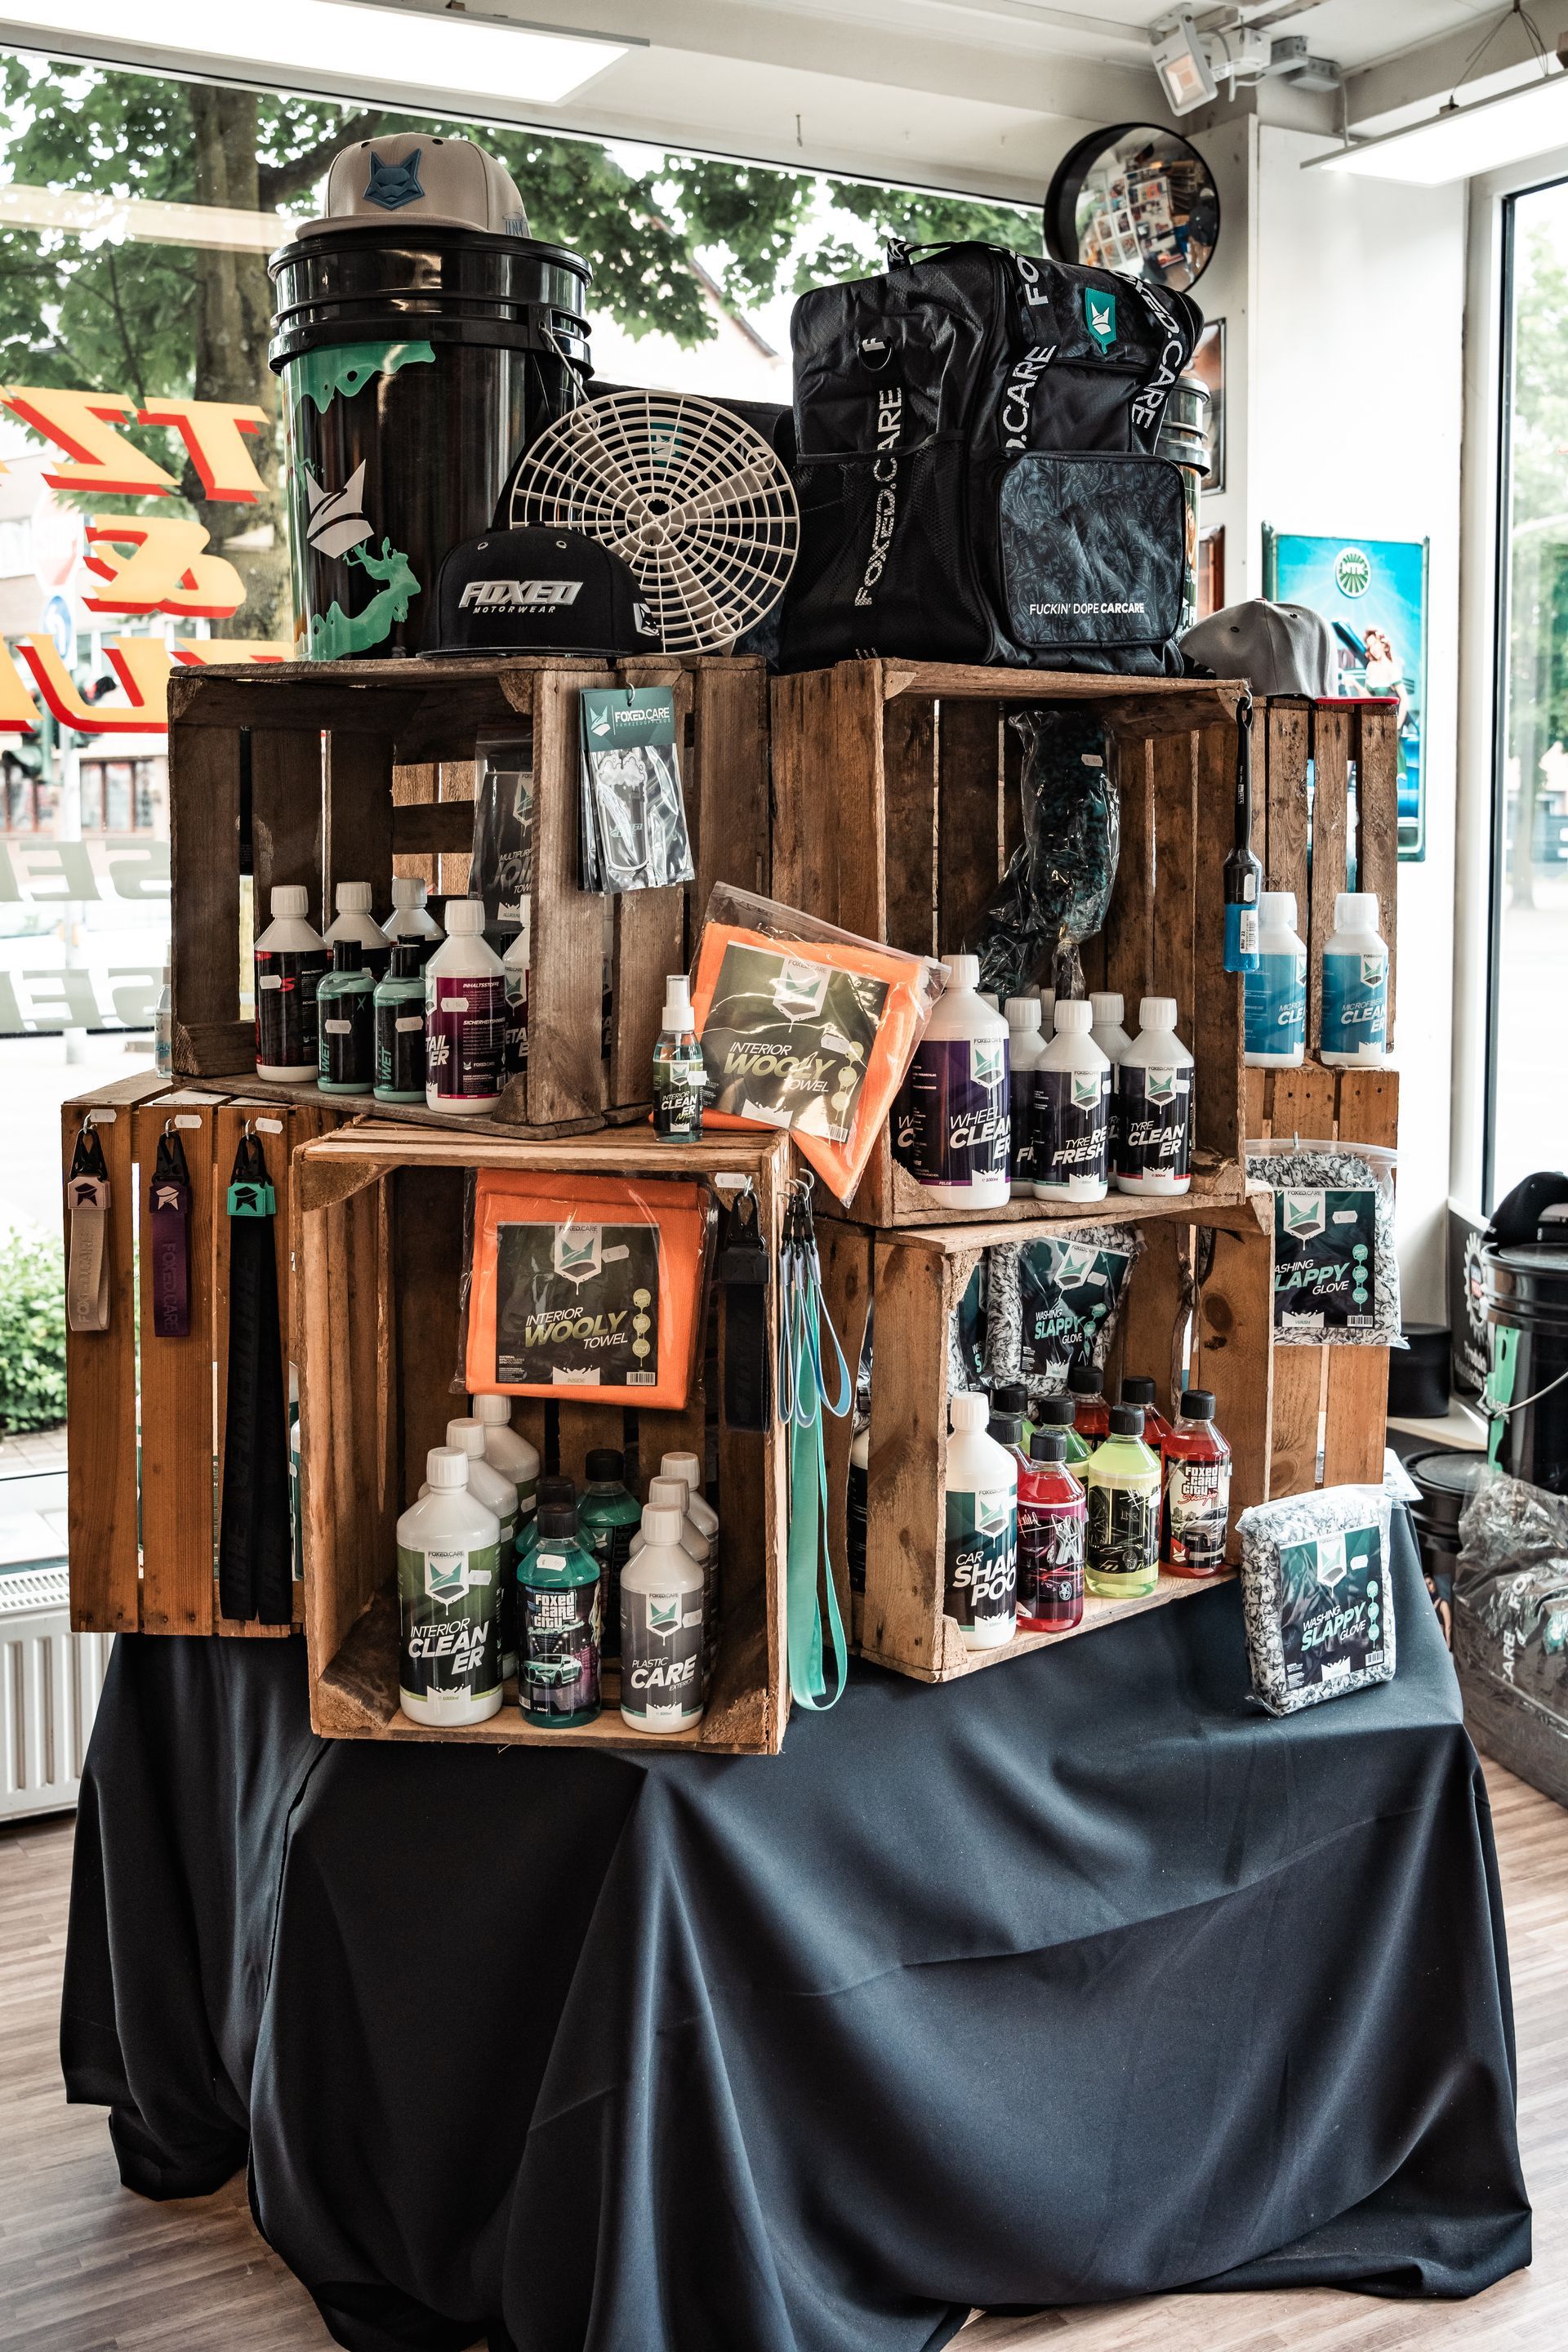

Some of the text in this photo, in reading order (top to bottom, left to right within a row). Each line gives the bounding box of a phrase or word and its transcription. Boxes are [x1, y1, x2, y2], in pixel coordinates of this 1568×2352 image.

[854, 387, 902, 606] FOXED.CARE
[459, 581, 583, 608] FOXED
[473, 605, 556, 614] MOTORWEAR
[1030, 602, 1144, 615] FUCKIN' DOPE CARCARE
[615, 707, 670, 723] FOXED.CARE
[1342, 998, 1384, 1012] MICROFIBER
[322, 1039, 330, 1071] WET
[430, 1049, 449, 1067] ER
[730, 1042, 792, 1055] INTERIOR
[382, 1046, 392, 1080] WET
[784, 1079, 829, 1093] TOWEL
[662, 1091, 689, 1101] INTERIOR
[662, 1094, 697, 1110] CLEAN
[681, 1105, 696, 1116] ER
[951, 1106, 1001, 1129] WHEEL
[1129, 1123, 1185, 1146] CLEAN
[1131, 1120, 1155, 1131] TYRE
[1066, 1136, 1091, 1149] TYRE
[1090, 1125, 1107, 1143] RE
[1052, 1142, 1106, 1166] FRESH
[1160, 1138, 1182, 1156] ER
[1312, 1281, 1349, 1295] GLOVE
[526, 1307, 583, 1326] INTERIOR
[1036, 1308, 1062, 1321] WASHING
[525, 1311, 628, 1348] WOOLY
[1035, 1316, 1087, 1340] SLAPPY
[583, 1333, 628, 1349] TOWEL
[1062, 1333, 1083, 1344] GLOVE
[956, 1551, 984, 1566] CAR
[971, 1566, 1016, 1606] POO
[411, 1618, 470, 1637] INTERIOR
[1301, 1601, 1365, 1651] SLAPPY
[1303, 1606, 1341, 1632] WASHING
[408, 1621, 489, 1658] CLEAN
[1340, 1619, 1366, 1641] GLOVE
[451, 1646, 484, 1675] ER
[632, 1657, 669, 1668] PLASTIC
[1503, 1630, 1516, 1683] ARE
[630, 1654, 697, 1689] CARE
[669, 1677, 694, 1691] EXTERIOR
